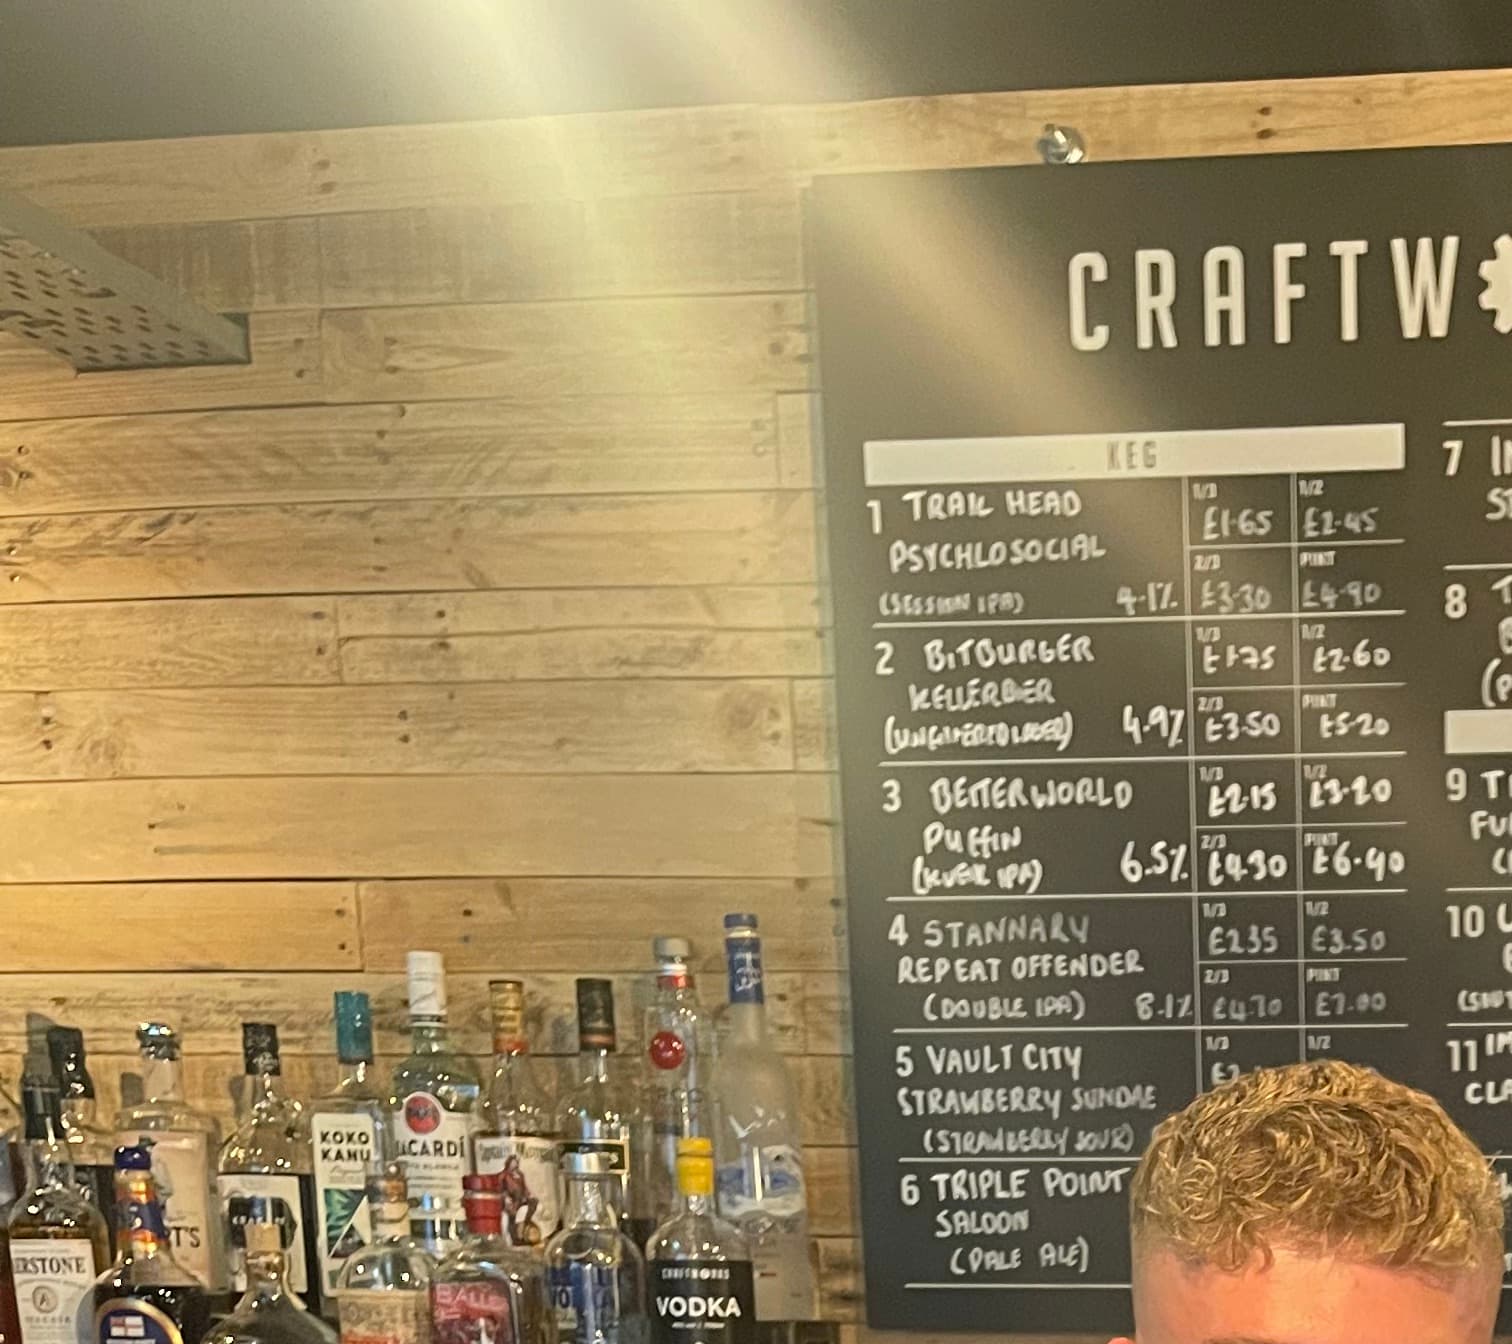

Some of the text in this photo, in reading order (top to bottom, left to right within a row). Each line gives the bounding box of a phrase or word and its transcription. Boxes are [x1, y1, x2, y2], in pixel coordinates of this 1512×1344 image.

[1107, 441, 1158, 470] KEG
[1443, 440, 1463, 476] 7
[902, 490, 1082, 521] TRAIL HEAD
[1445, 583, 1467, 619] 8
[875, 642, 894, 674] 2
[882, 780, 901, 812] 3
[1446, 768, 1467, 799] 9
[889, 912, 1090, 948] 4 STANNARY
[1447, 906, 1485, 938] 10
[898, 949, 1144, 983] REPEAT OFFENDER
[896, 1045, 1082, 1082] 5 VAULT CITY
[1447, 1040, 1477, 1072] 11
[898, 1087, 1060, 1119] STRAWBERRY
[320, 1130, 370, 1146] KOKO
[321, 1145, 371, 1162] KANU
[901, 1167, 1131, 1205] 6 TRIPLE POINT
[936, 1210, 1029, 1238] SALOON
[1041, 1236, 1089, 1271] ALE)
[656, 1297, 742, 1319] VODKA
